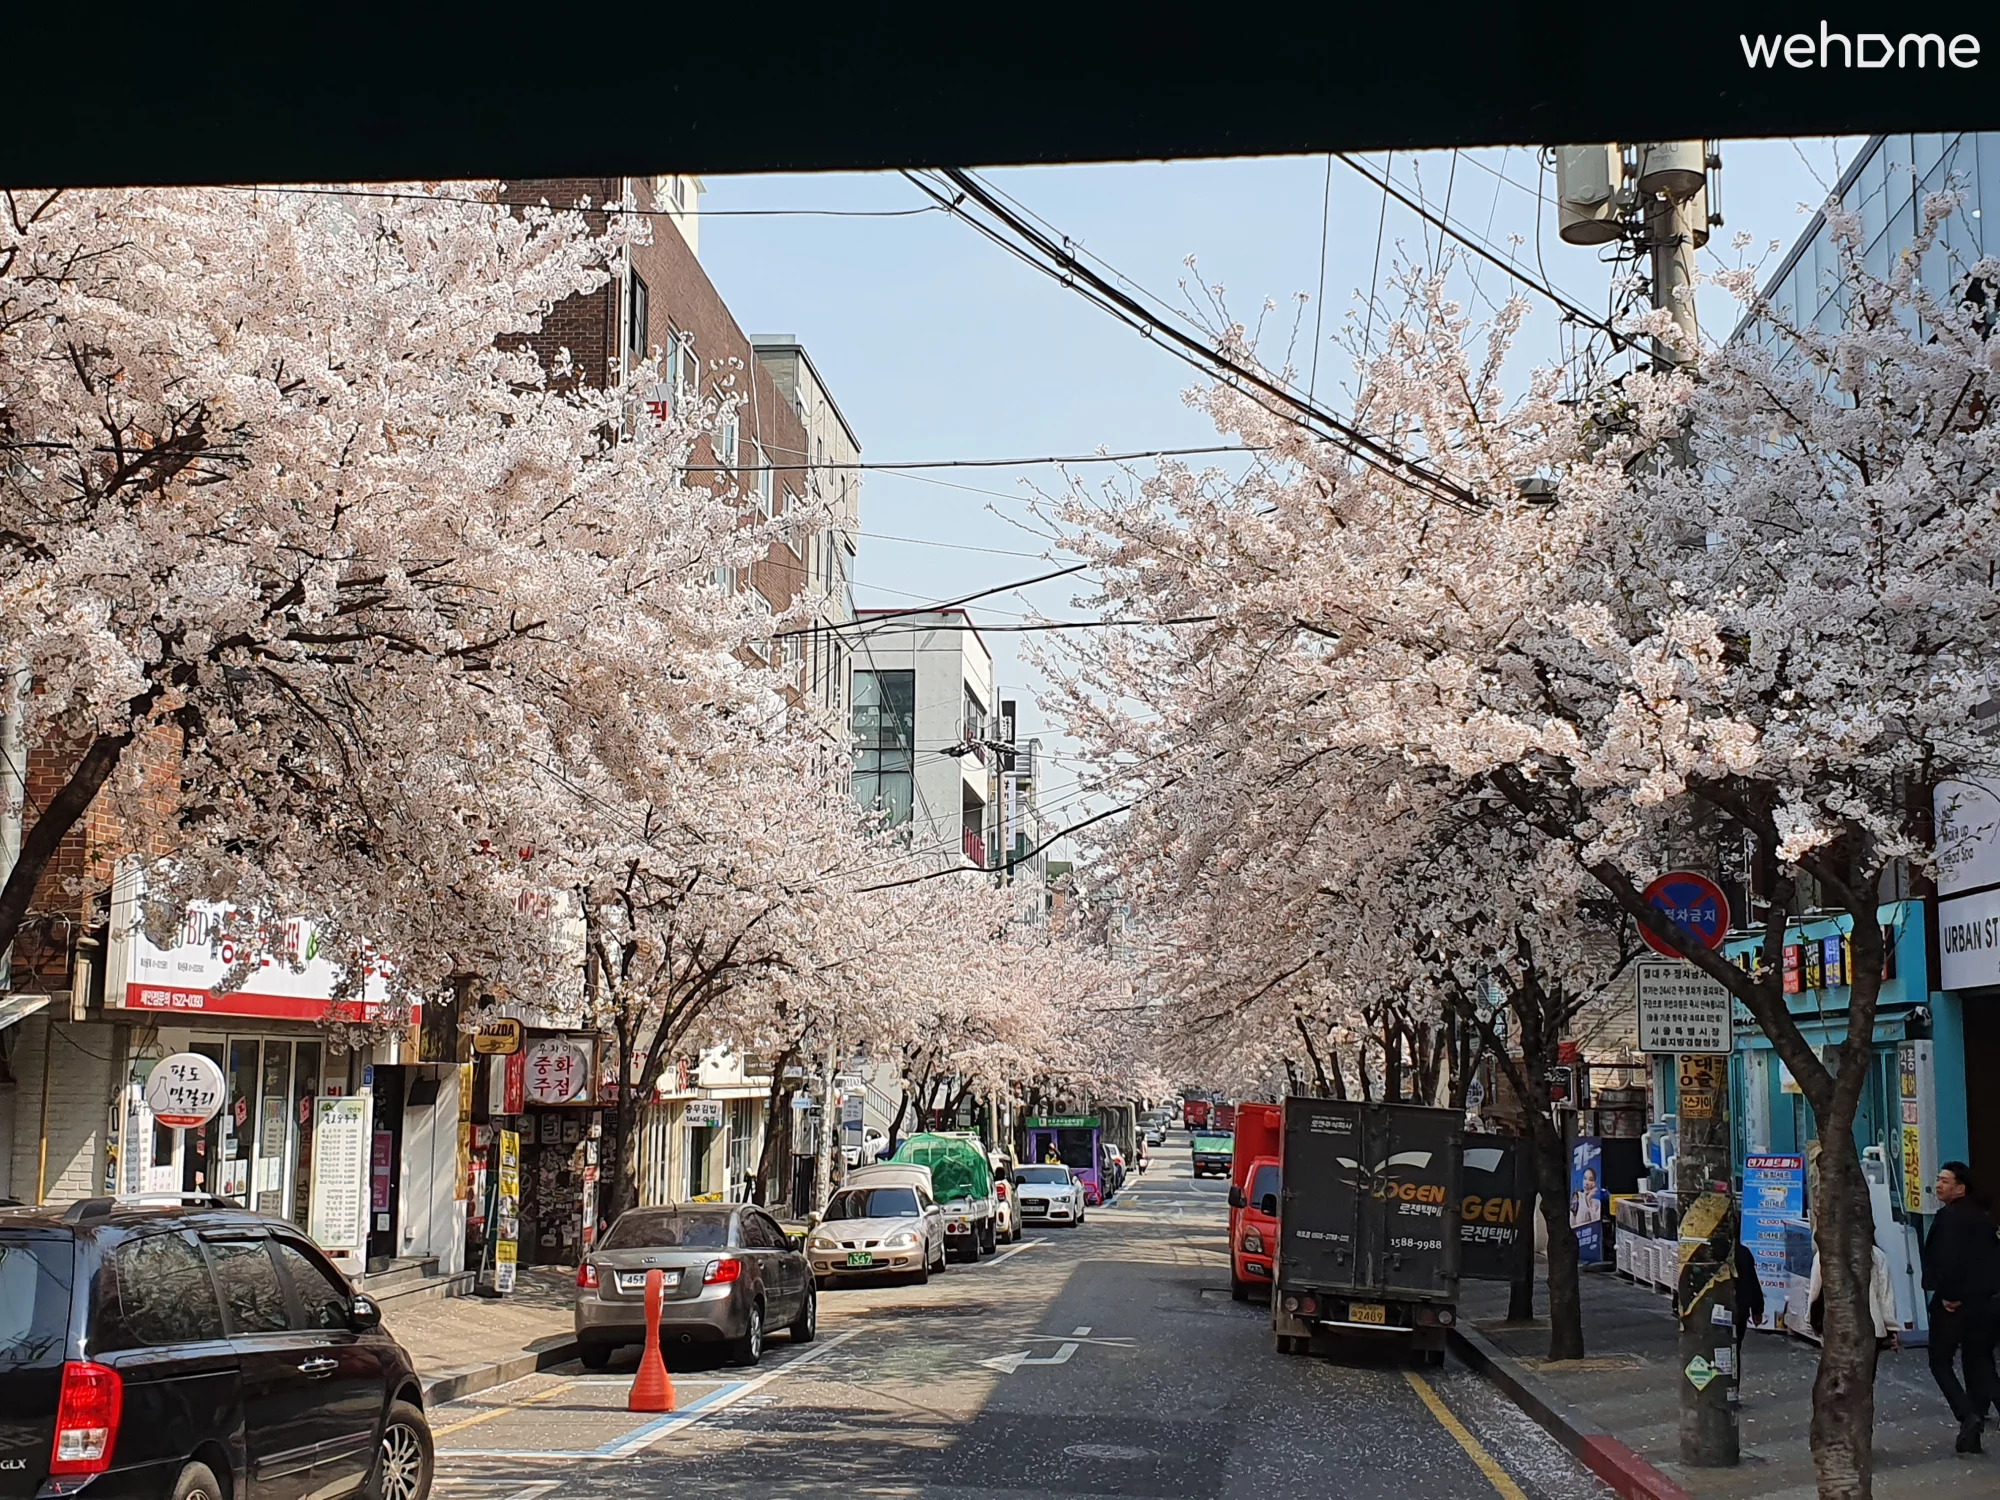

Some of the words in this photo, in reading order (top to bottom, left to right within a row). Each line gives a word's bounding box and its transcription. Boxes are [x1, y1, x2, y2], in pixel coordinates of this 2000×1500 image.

[1944, 921, 1981, 954] URBAN
[1985, 917, 2000, 949] ST
[533, 1056, 573, 1075] 중화
[533, 1078, 570, 1096] 주점
[169, 1086, 214, 1107] 막걸리
[1398, 1202, 1443, 1217] 로젠택배
[1390, 1237, 1443, 1249] 1588-9988
